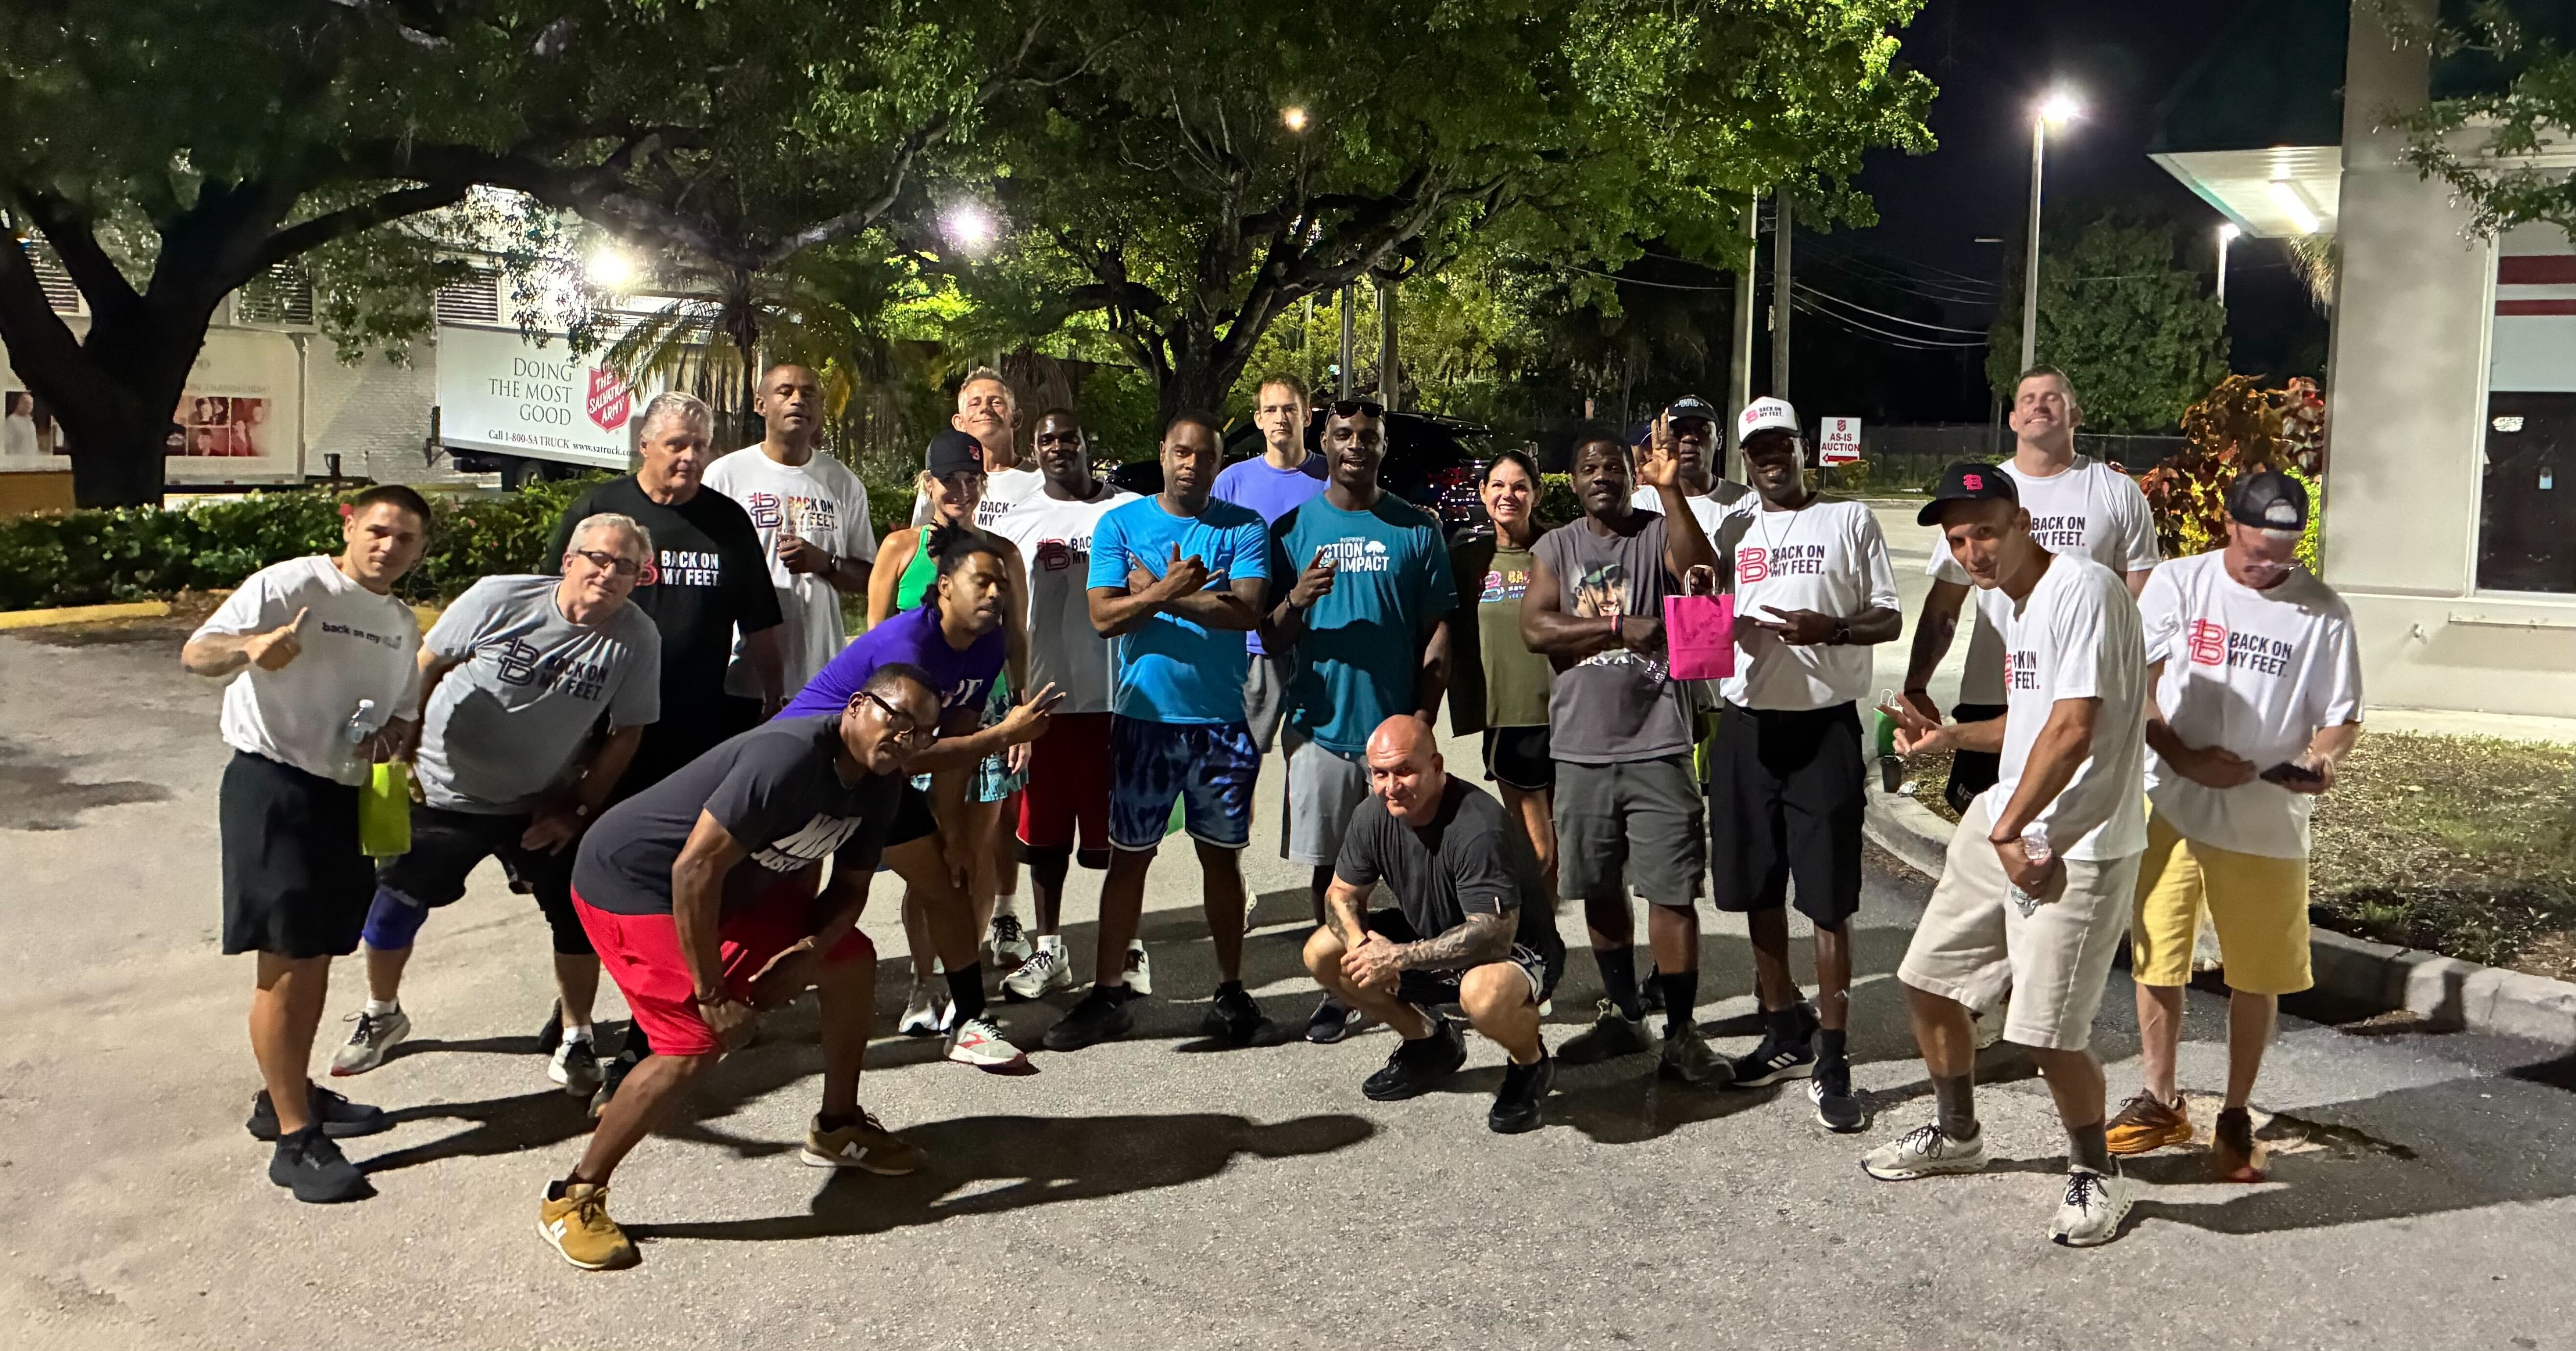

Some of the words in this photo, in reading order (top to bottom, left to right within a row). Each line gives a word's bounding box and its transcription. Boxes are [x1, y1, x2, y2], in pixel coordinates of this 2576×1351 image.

[514, 357, 572, 382] DOING
[488, 378, 520, 397] THE
[526, 383, 572, 403] MOST
[595, 372, 613, 393] THE
[589, 377, 627, 414] SALVATION
[520, 404, 571, 425] GOOD
[602, 395, 625, 424] ARMY
[488, 429, 503, 440] Call
[1830, 433, 1852, 441] AS-IS
[1821, 442, 1861, 452] AUCTION
[787, 496, 818, 512] BACK
[820, 499, 834, 514] ON
[980, 501, 1010, 514] BACK
[978, 513, 995, 527] MY
[2032, 516, 2065, 531] BACK
[2067, 516, 2086, 531] ON
[1070, 536, 1092, 551] BAC
[2031, 531, 2049, 546] MY
[1072, 551, 1087, 565] MY
[1315, 542, 1363, 558] ACTION
[1772, 545, 1804, 561] BACK
[1807, 545, 1825, 559] ON
[661, 550, 698, 569] BACK
[700, 553, 719, 570] ON
[1340, 555, 1390, 573] IMPACT
[1791, 559, 1826, 575] FEET.
[661, 567, 682, 585] MY
[322, 622, 349, 634] back
[354, 629, 364, 638] on
[366, 633, 381, 644] my
[2229, 631, 2270, 654] BACK
[2272, 640, 2292, 660] ON
[2026, 651, 2037, 670] ON
[2226, 650, 2248, 669] MY
[587, 665, 609, 683] ON
